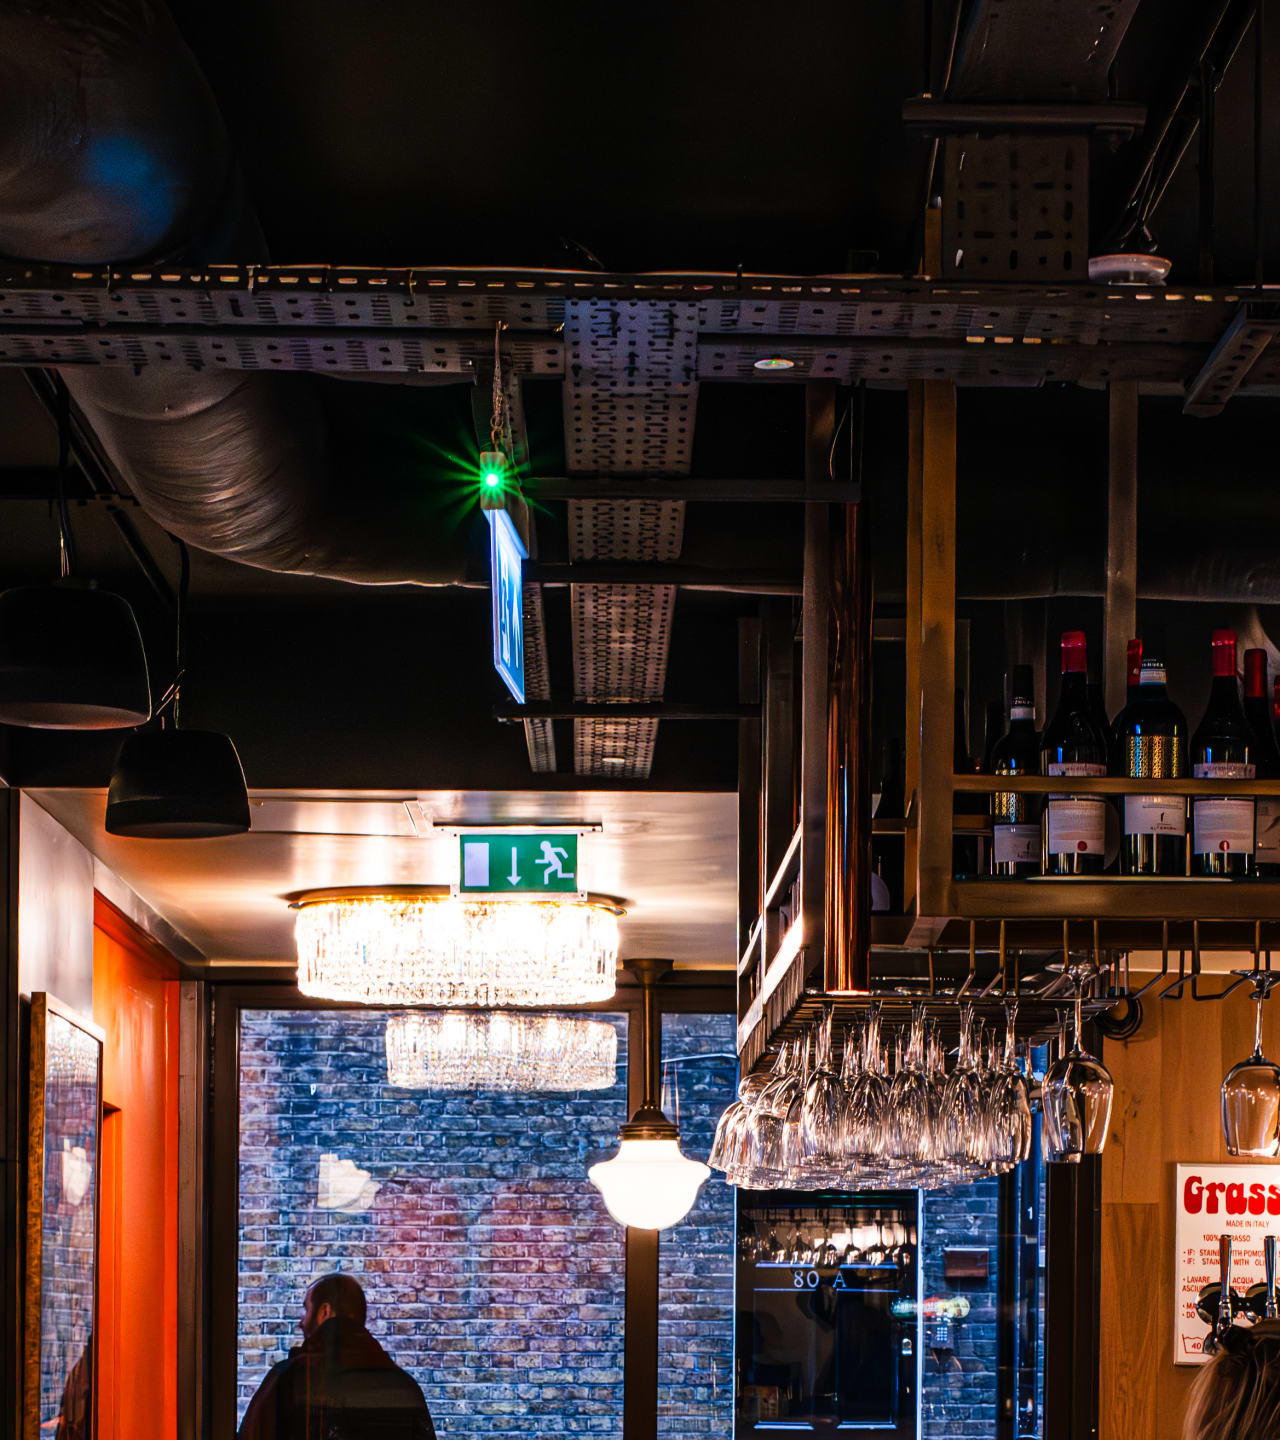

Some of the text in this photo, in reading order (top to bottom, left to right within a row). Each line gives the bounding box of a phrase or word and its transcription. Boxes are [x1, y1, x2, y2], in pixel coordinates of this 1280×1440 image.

[1226, 1220, 1244, 1228] MADE
[1252, 1220, 1270, 1229] ITALY
[1231, 1234, 1251, 1242] RASSO
[1254, 1259, 1265, 1267] OLI
[793, 1270, 847, 1288] 80 A
